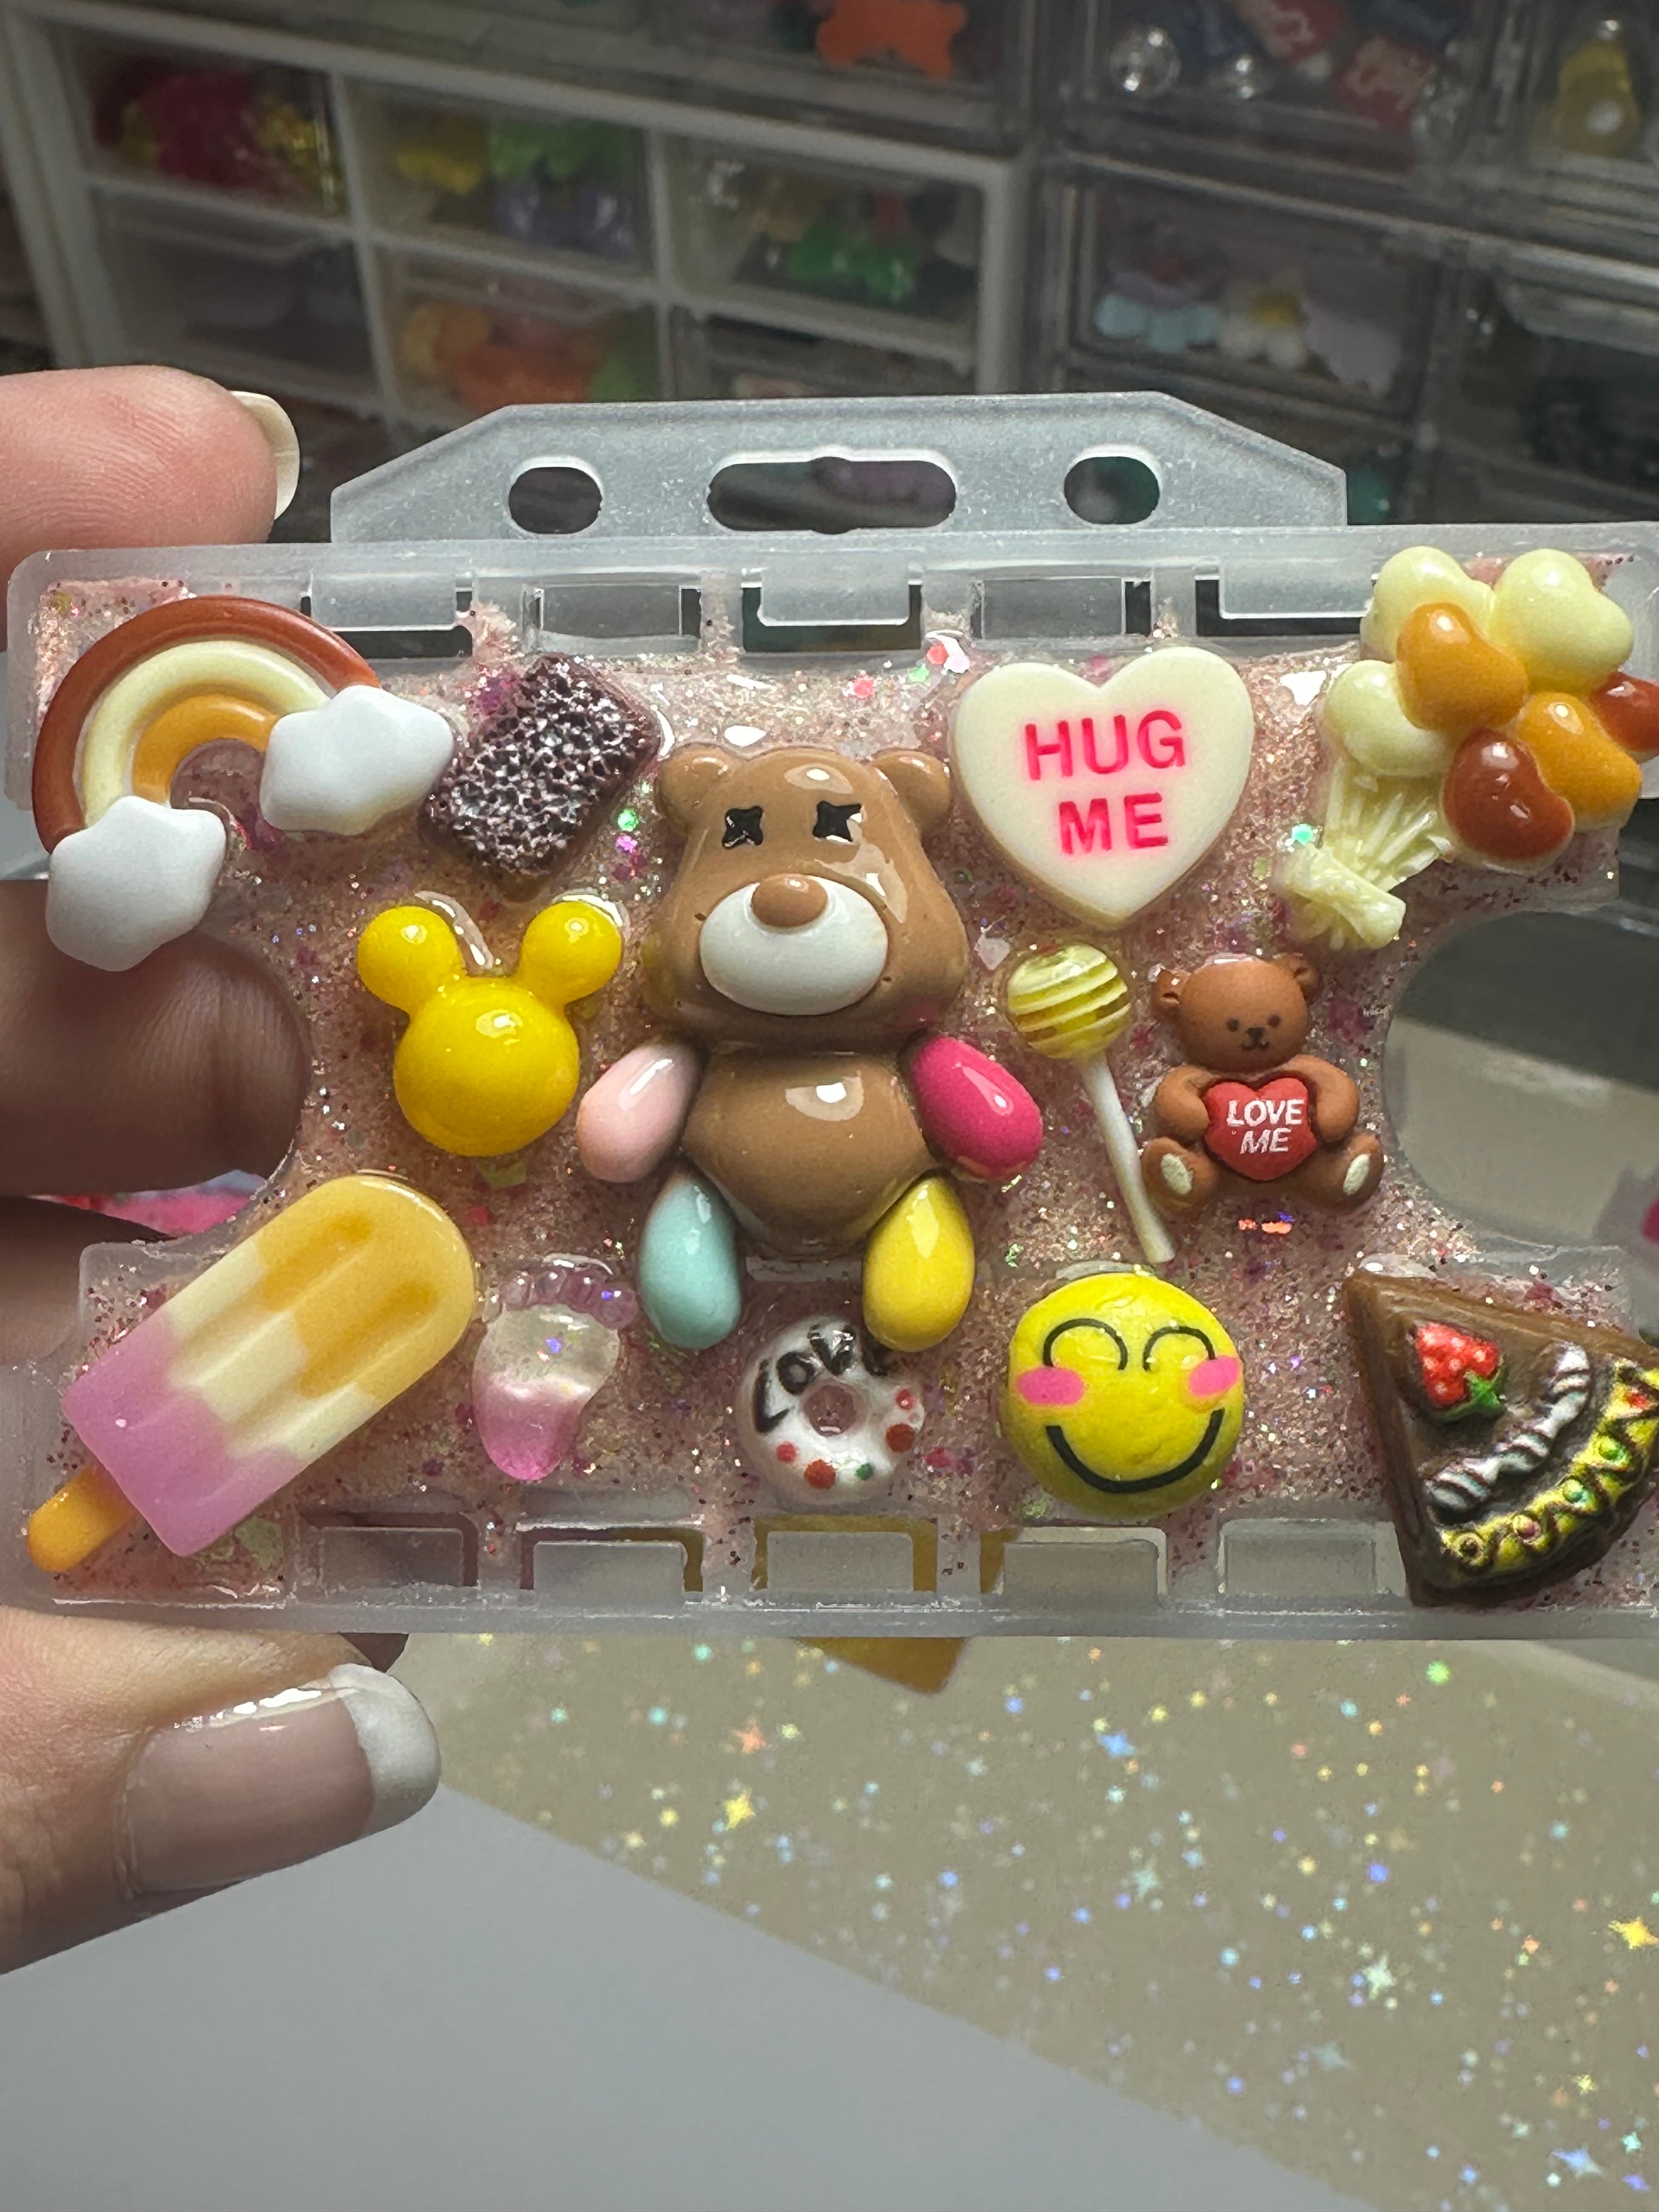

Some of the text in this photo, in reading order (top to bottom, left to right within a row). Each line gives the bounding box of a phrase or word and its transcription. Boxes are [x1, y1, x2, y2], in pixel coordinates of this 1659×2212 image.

[1025, 710, 1186, 781] HUG
[1058, 792, 1169, 855] ME
[1226, 1099, 1305, 1127] LOVE
[1239, 1127, 1292, 1154] ME
